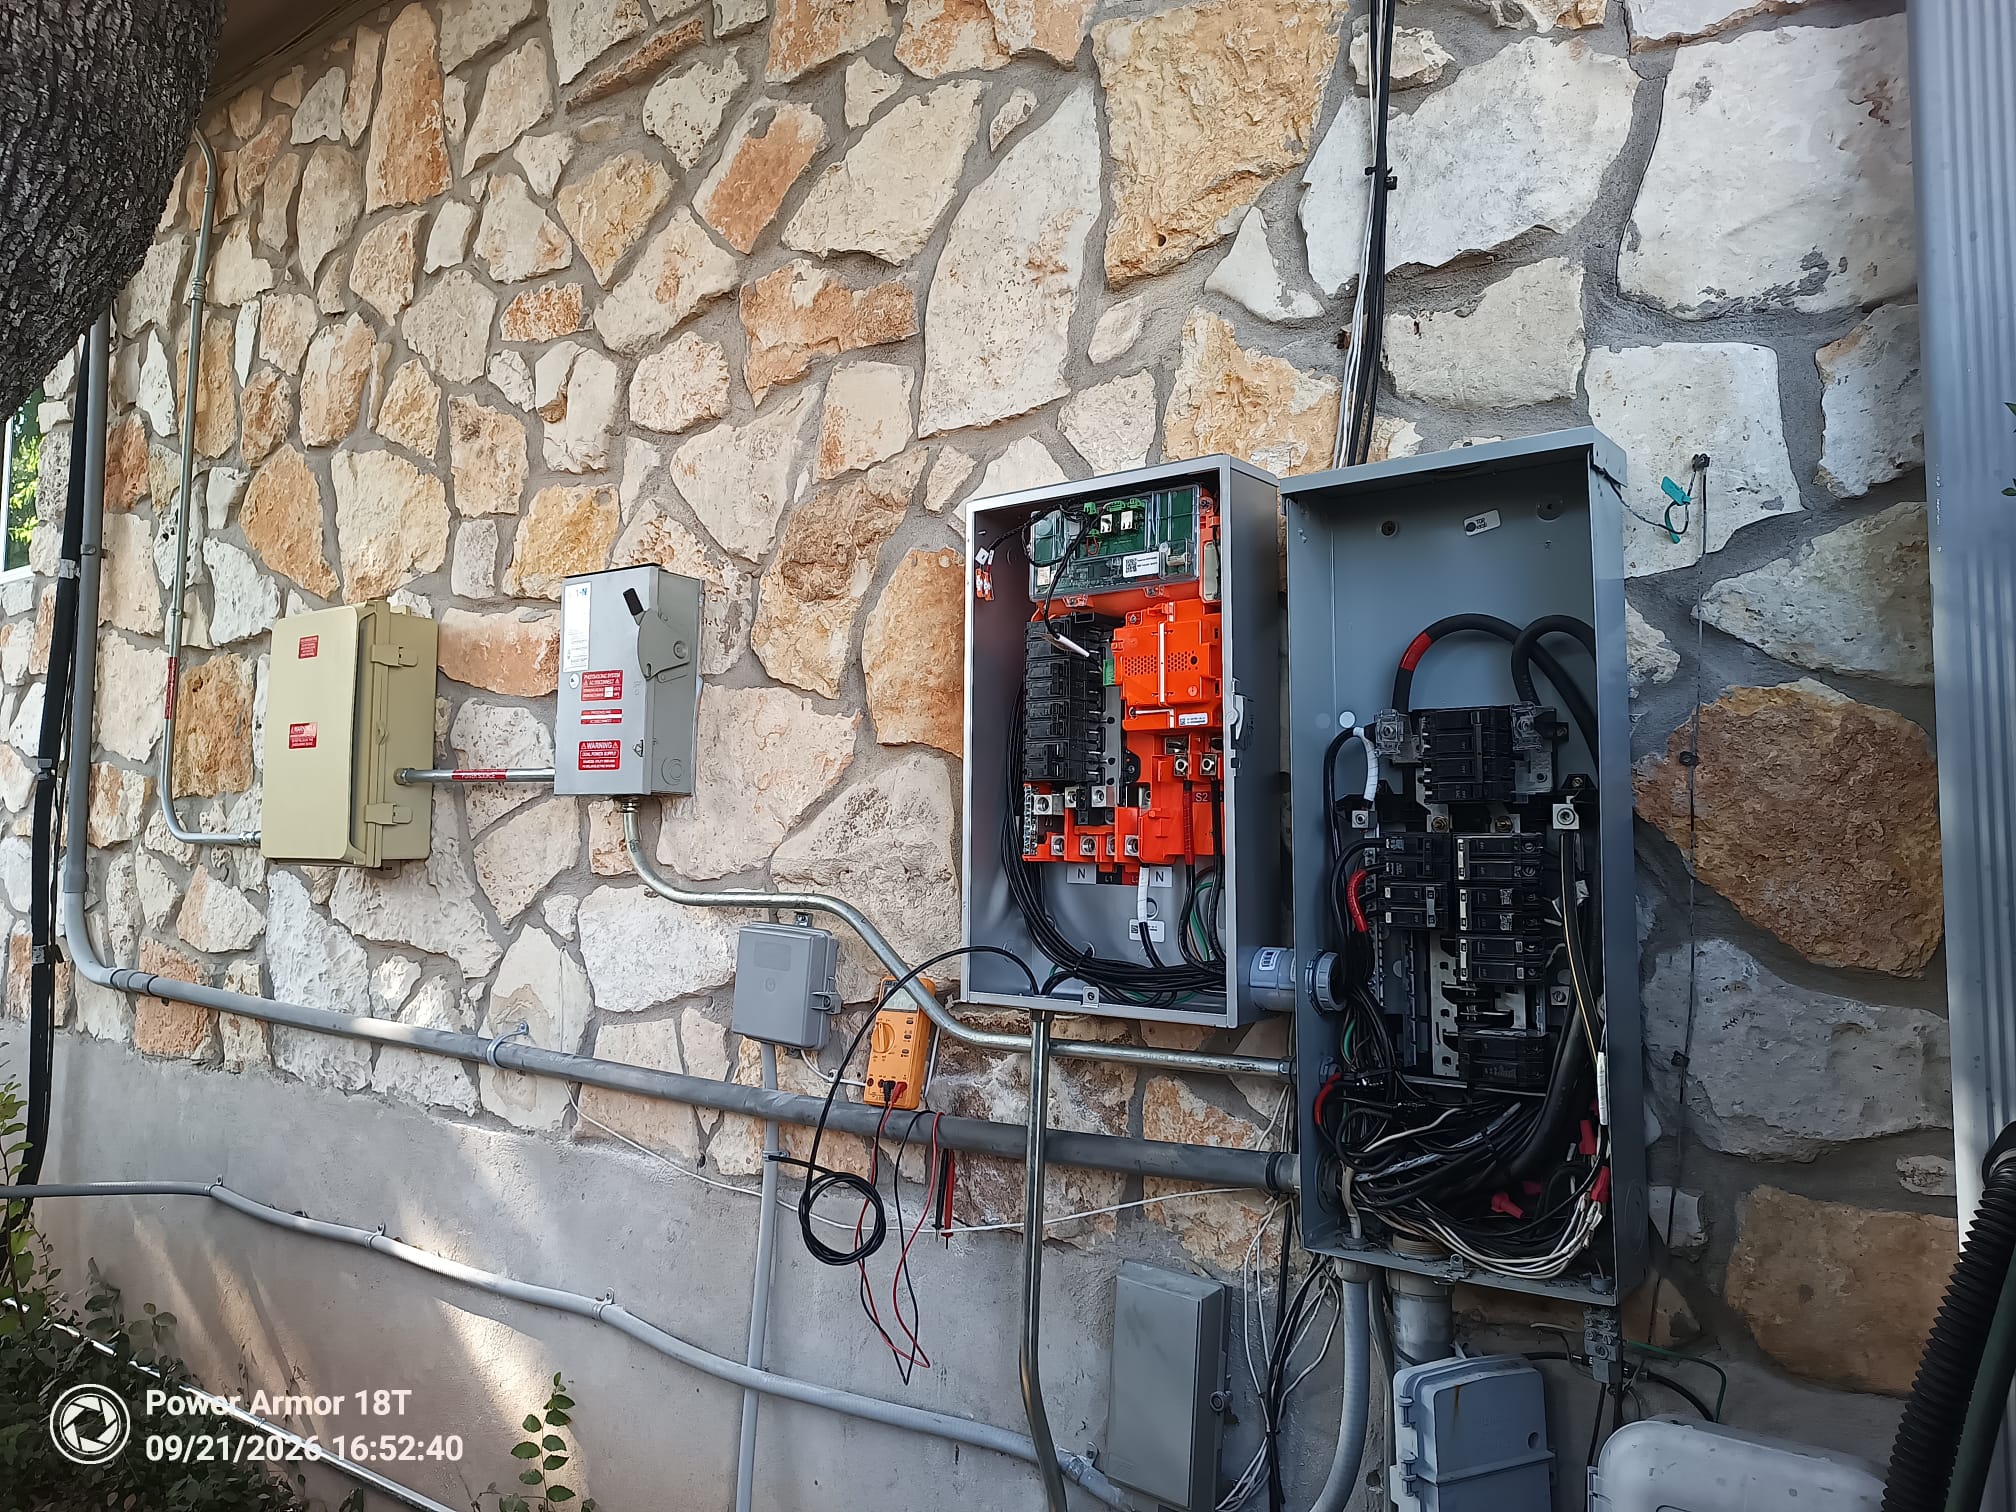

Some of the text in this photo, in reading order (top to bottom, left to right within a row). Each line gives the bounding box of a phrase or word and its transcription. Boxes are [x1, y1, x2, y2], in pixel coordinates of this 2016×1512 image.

[1195, 792, 1208, 802] S2
[1077, 867, 1086, 879] N
[1155, 871, 1164, 882] N
